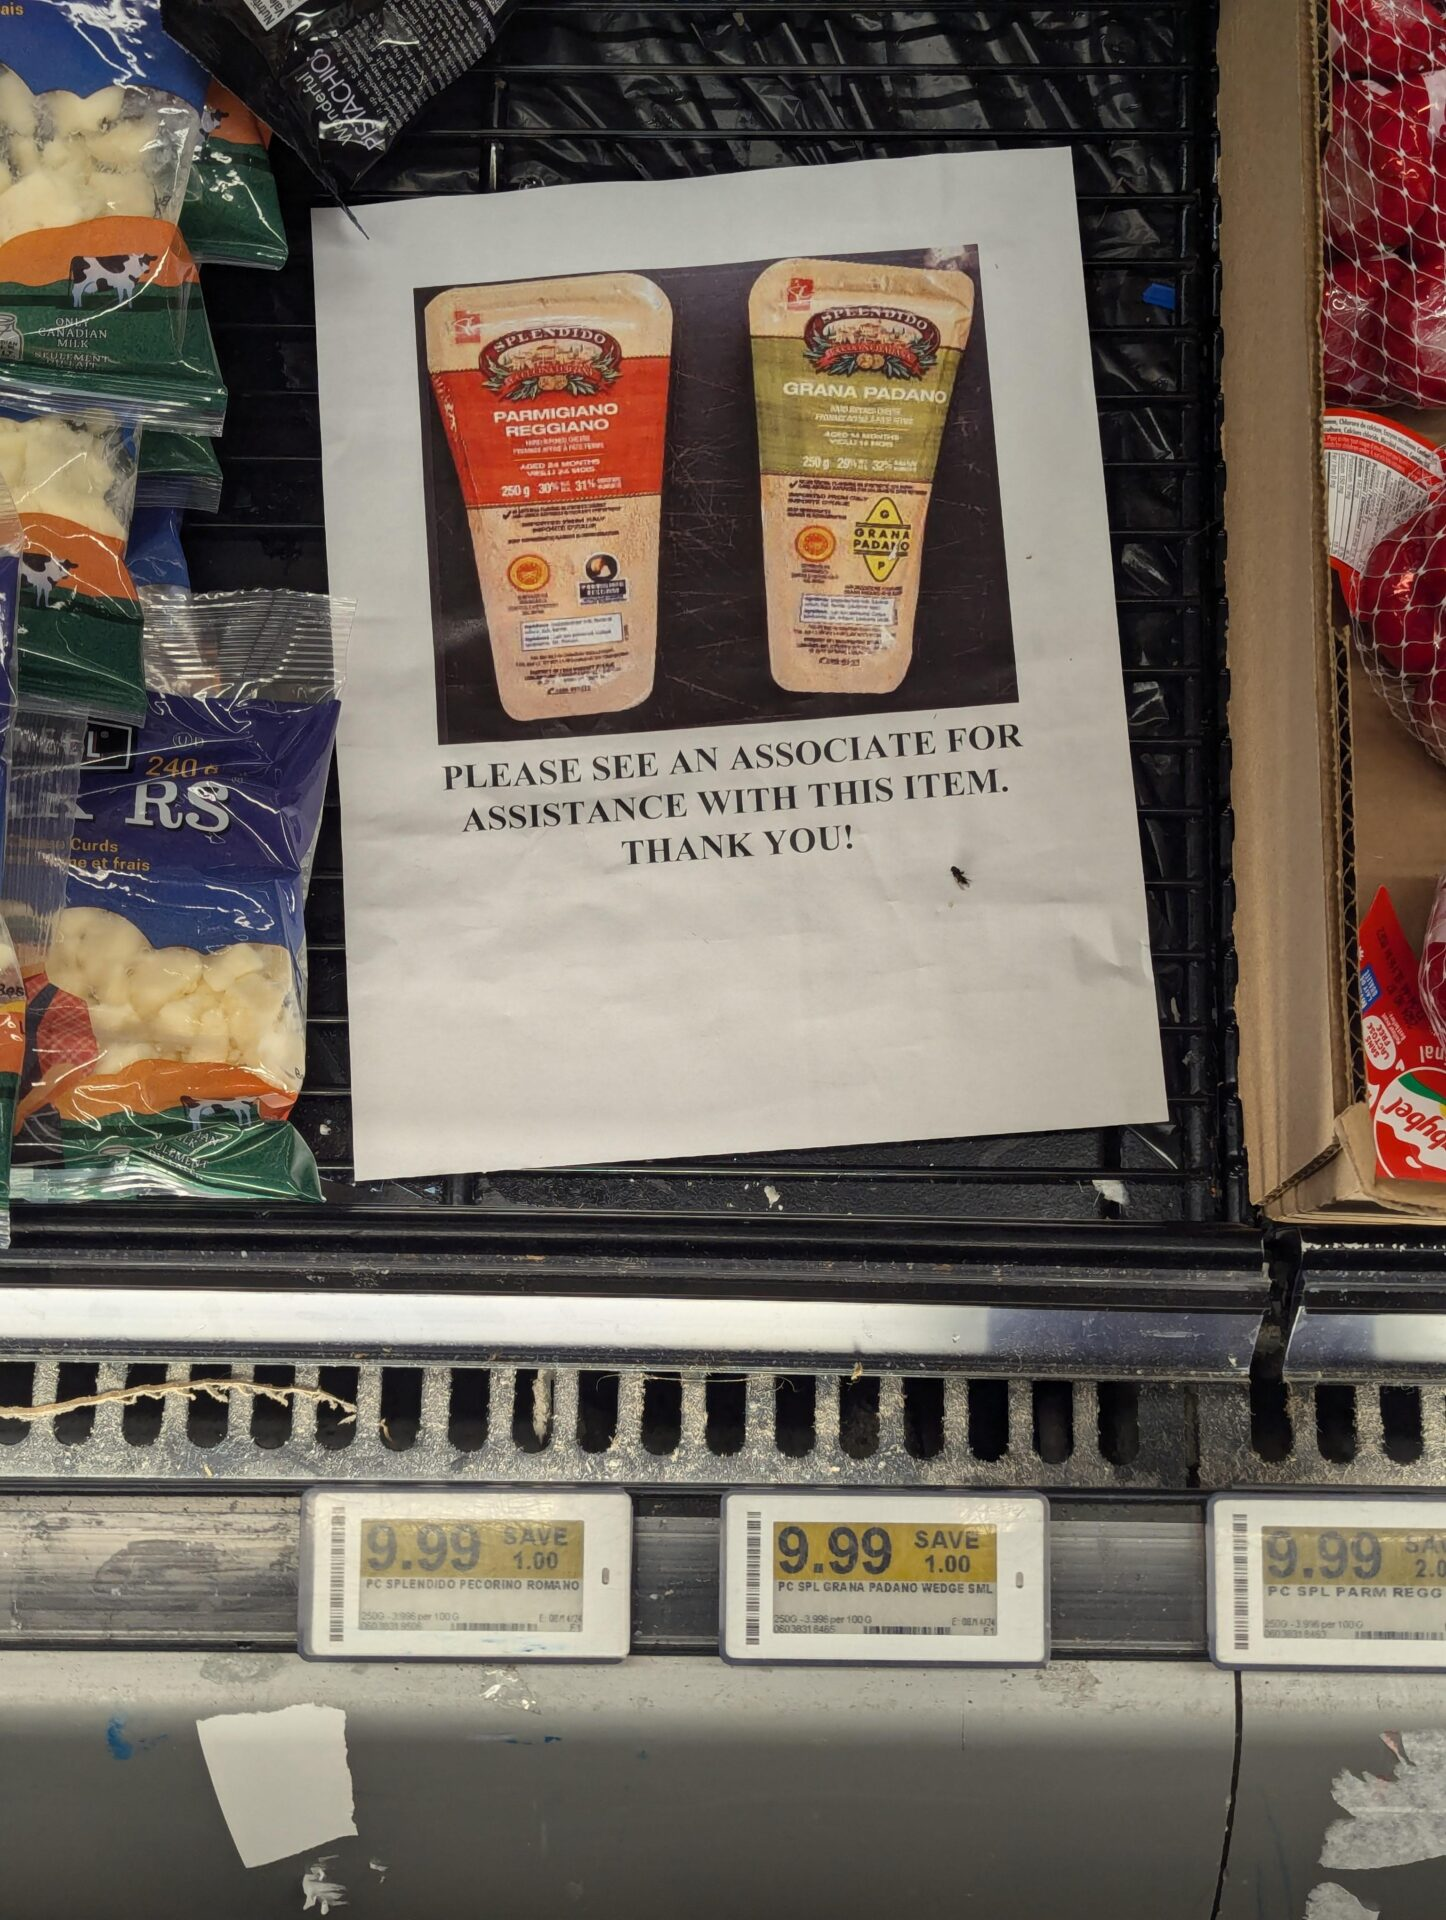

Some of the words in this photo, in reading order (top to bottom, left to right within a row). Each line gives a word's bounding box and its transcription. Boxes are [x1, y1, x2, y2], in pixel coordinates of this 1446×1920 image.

[297, 71, 354, 146] Wonderful
[55, 317, 89, 328] ONLY
[820, 307, 929, 331] SPLENDIDO
[38, 327, 107, 339] CANADIAN
[494, 326, 608, 354] SPLENDIDO
[57, 339, 89, 349] MILK
[783, 381, 858, 399] GRANA
[863, 386, 947, 405] PADANO
[493, 402, 619, 424] PARMIGIANO
[505, 418, 610, 438] REGGIANO
[802, 455, 821, 468] 250
[501, 484, 520, 498] 250
[854, 527, 911, 540] GRANA
[853, 538, 911, 552] PADANO
[877, 560, 886, 571] P
[145, 755, 199, 778] 240
[442, 757, 582, 791] PLEASE
[592, 751, 659, 782] SEE
[670, 746, 719, 776] AN
[729, 730, 937, 771] ASSOCIATE
[945, 723, 1024, 753] FOR
[462, 792, 688, 833] ASSISTANCE
[697, 785, 800, 816] WITH
[808, 777, 894, 809] THIS
[902, 768, 1009, 801] ITEM.
[70, 838, 119, 853] Curds
[621, 831, 754, 866] THANK
[763, 824, 853, 856] YOU!
[91, 856, 106, 870] et
[112, 857, 151, 872] frais
[1366, 1022, 1390, 1060] LACTOSE
[1376, 1024, 1392, 1048] FREE
[1365, 1036, 1380, 1059] SANS
[1419, 1045, 1446, 1063] nal
[154, 1142, 208, 1169] ULEMENT
[367, 1523, 481, 1572] 9.99
[504, 1526, 569, 1547] SAVE
[778, 1526, 892, 1575] 9.99
[915, 1530, 980, 1550] SAVE
[1266, 1530, 1383, 1580] 9.99
[513, 1551, 558, 1570] 1.00
[924, 1554, 971, 1574] 1.00
[366, 1578, 382, 1590] PC
[386, 1579, 456, 1590] SPLENDIDO
[460, 1579, 523, 1591] PECORINO
[527, 1580, 580, 1591] ROMANO
[778, 1581, 794, 1592] PC
[798, 1582, 820, 1593] SPL
[823, 1582, 865, 1593] GRANA
[869, 1582, 918, 1593] PADANO
[921, 1583, 965, 1594] WEDGE
[968, 1583, 993, 1594] SML
[1268, 1586, 1291, 1598] PC
[1297, 1586, 1331, 1598] SPL
[1336, 1586, 1388, 1598] PARM
[1392, 1587, 1442, 1599] REGG
[417, 1613, 433, 1624] per
[830, 1617, 845, 1627] per
[846, 1615, 864, 1626] 100
[864, 1615, 873, 1625] G
[1320, 1621, 1335, 1631] per
